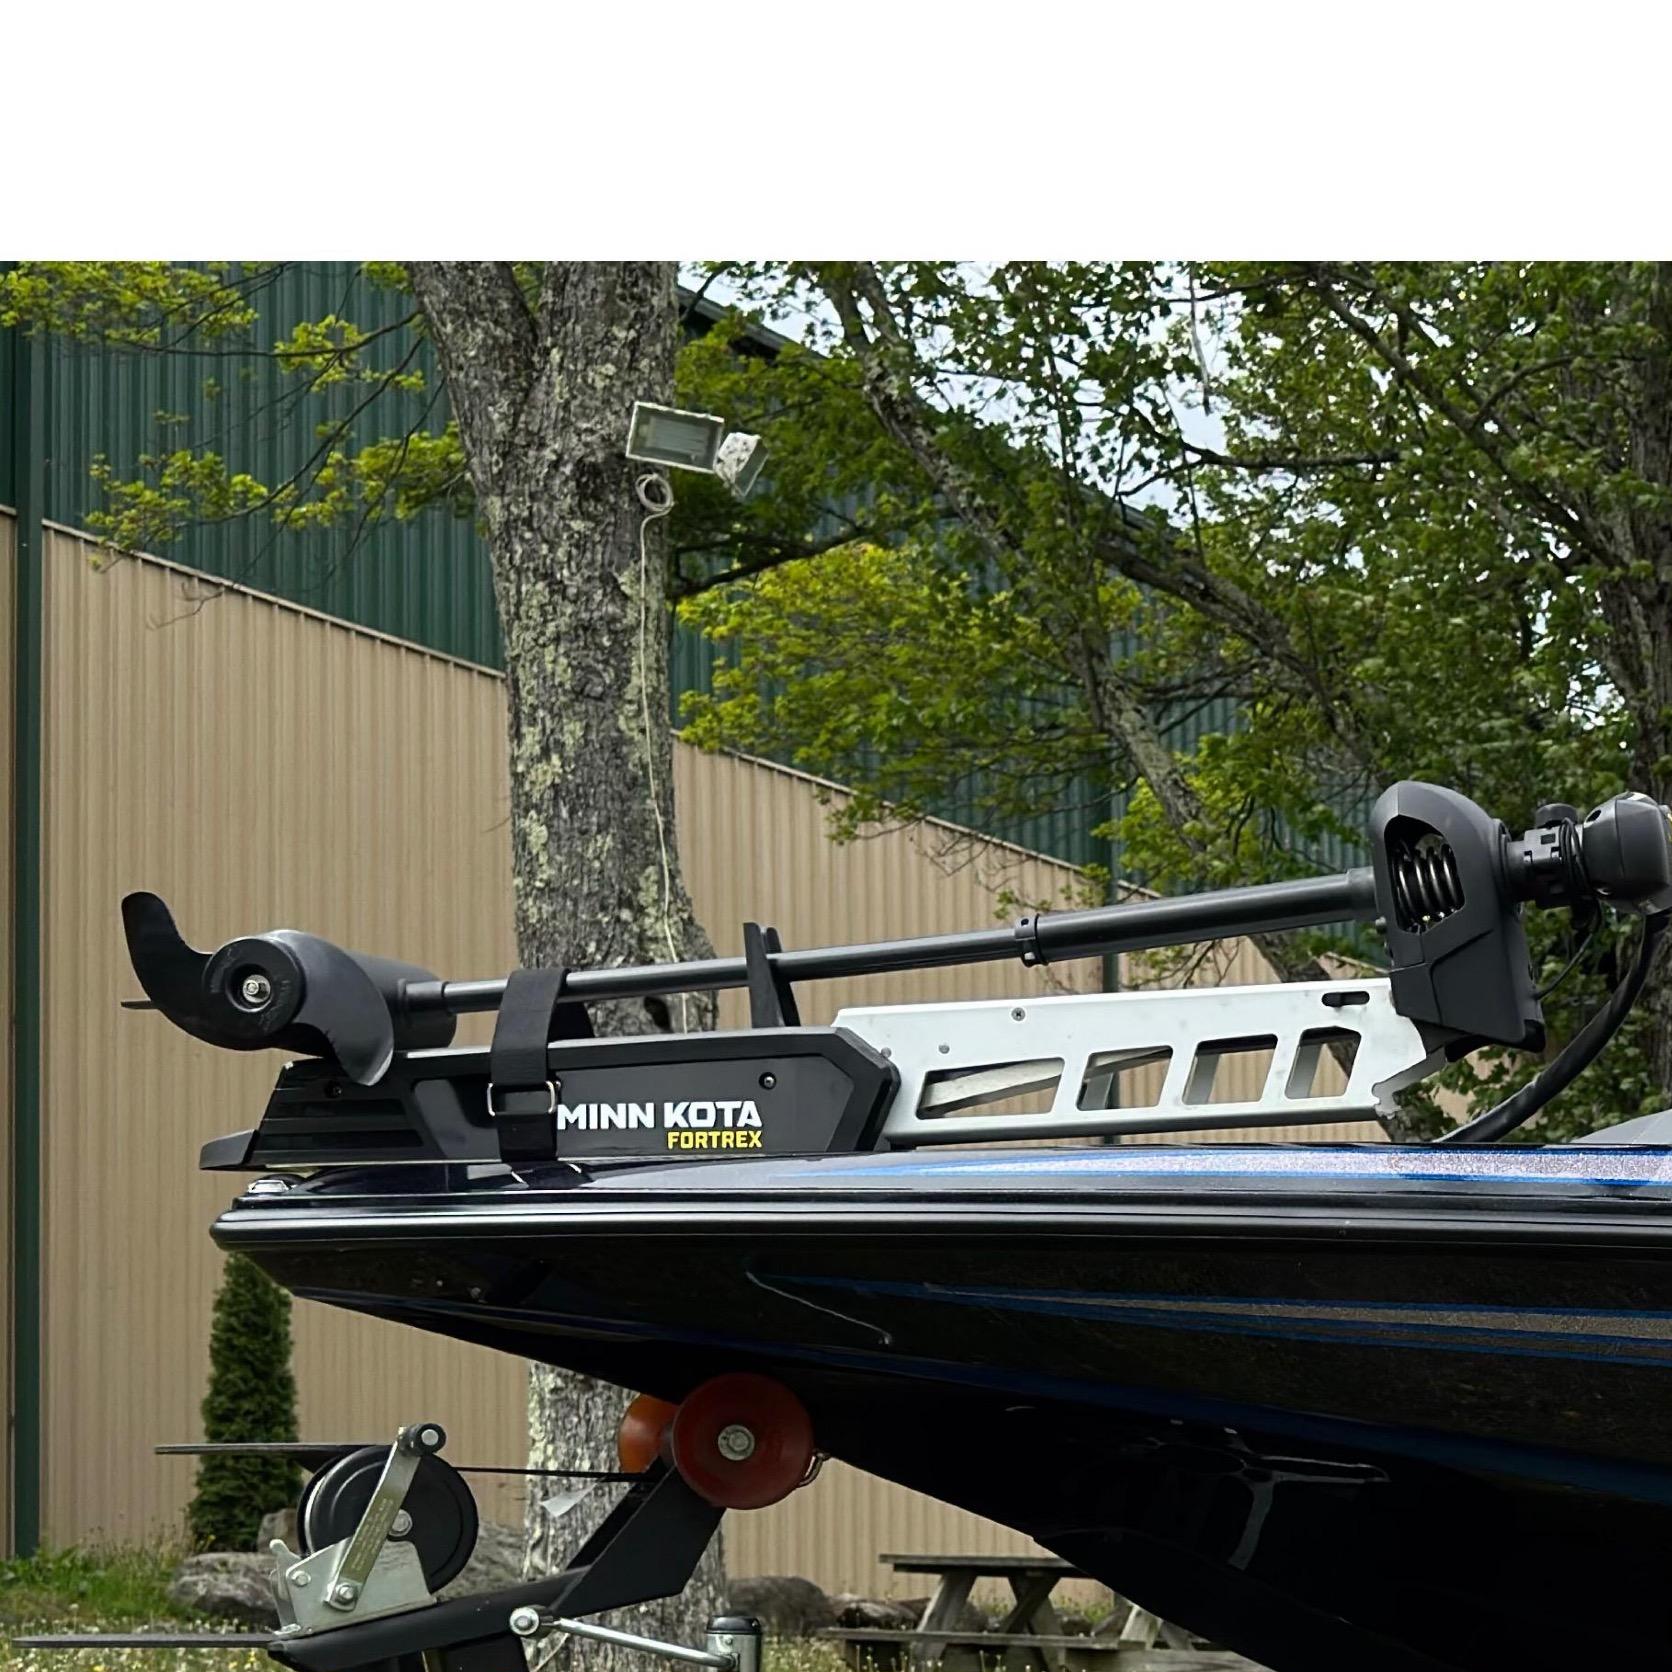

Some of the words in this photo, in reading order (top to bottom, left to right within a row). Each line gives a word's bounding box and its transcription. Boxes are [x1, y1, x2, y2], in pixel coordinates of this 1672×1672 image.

[557, 1102, 655, 1131] MINN
[663, 1100, 763, 1129] KOTA
[667, 1130, 763, 1150] FORTREX
